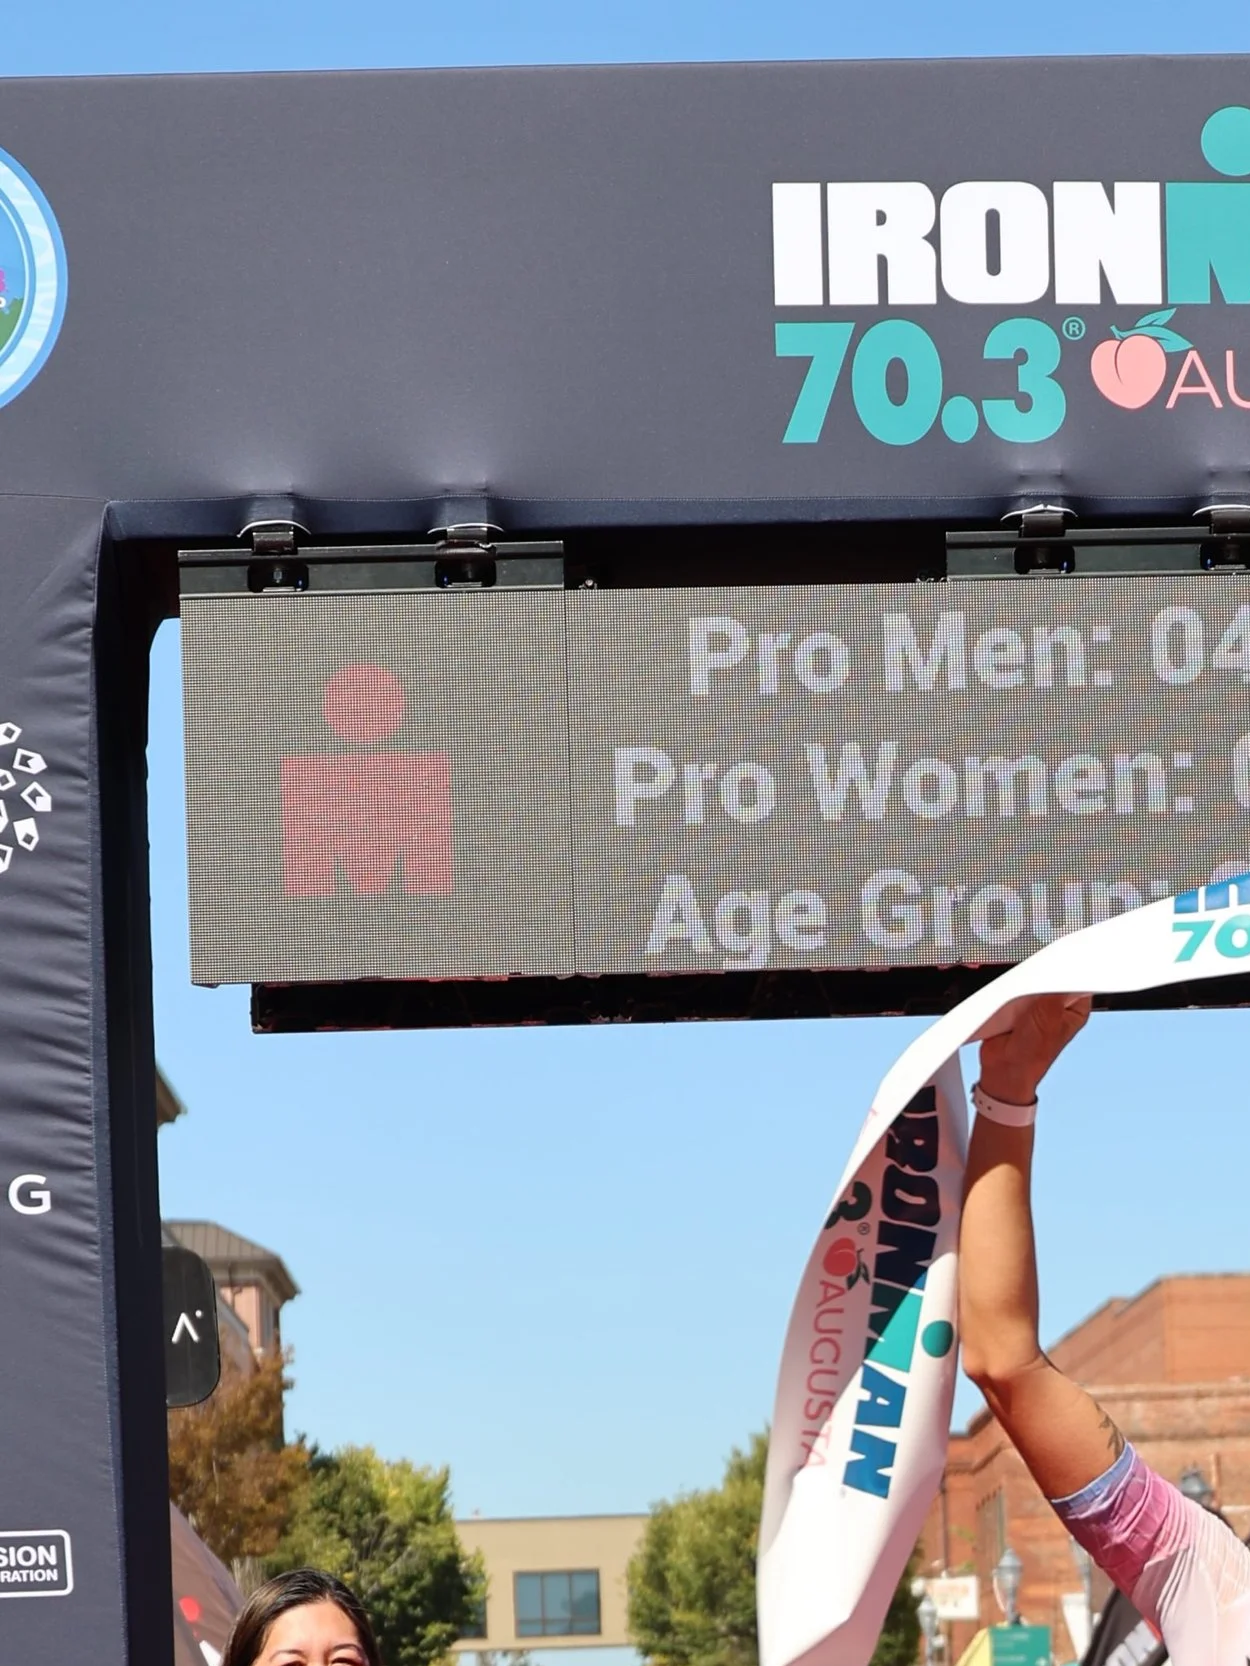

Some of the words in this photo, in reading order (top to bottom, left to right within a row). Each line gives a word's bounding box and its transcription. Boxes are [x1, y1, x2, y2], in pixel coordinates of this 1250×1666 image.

[774, 318, 1066, 446] 70.3
[686, 612, 852, 697] Pro
[884, 610, 1113, 693] Men:
[611, 743, 778, 827] Pro
[806, 737, 1196, 824] Women:
[644, 874, 827, 970] Age
[801, 1279, 846, 1469] AUGUSTA
